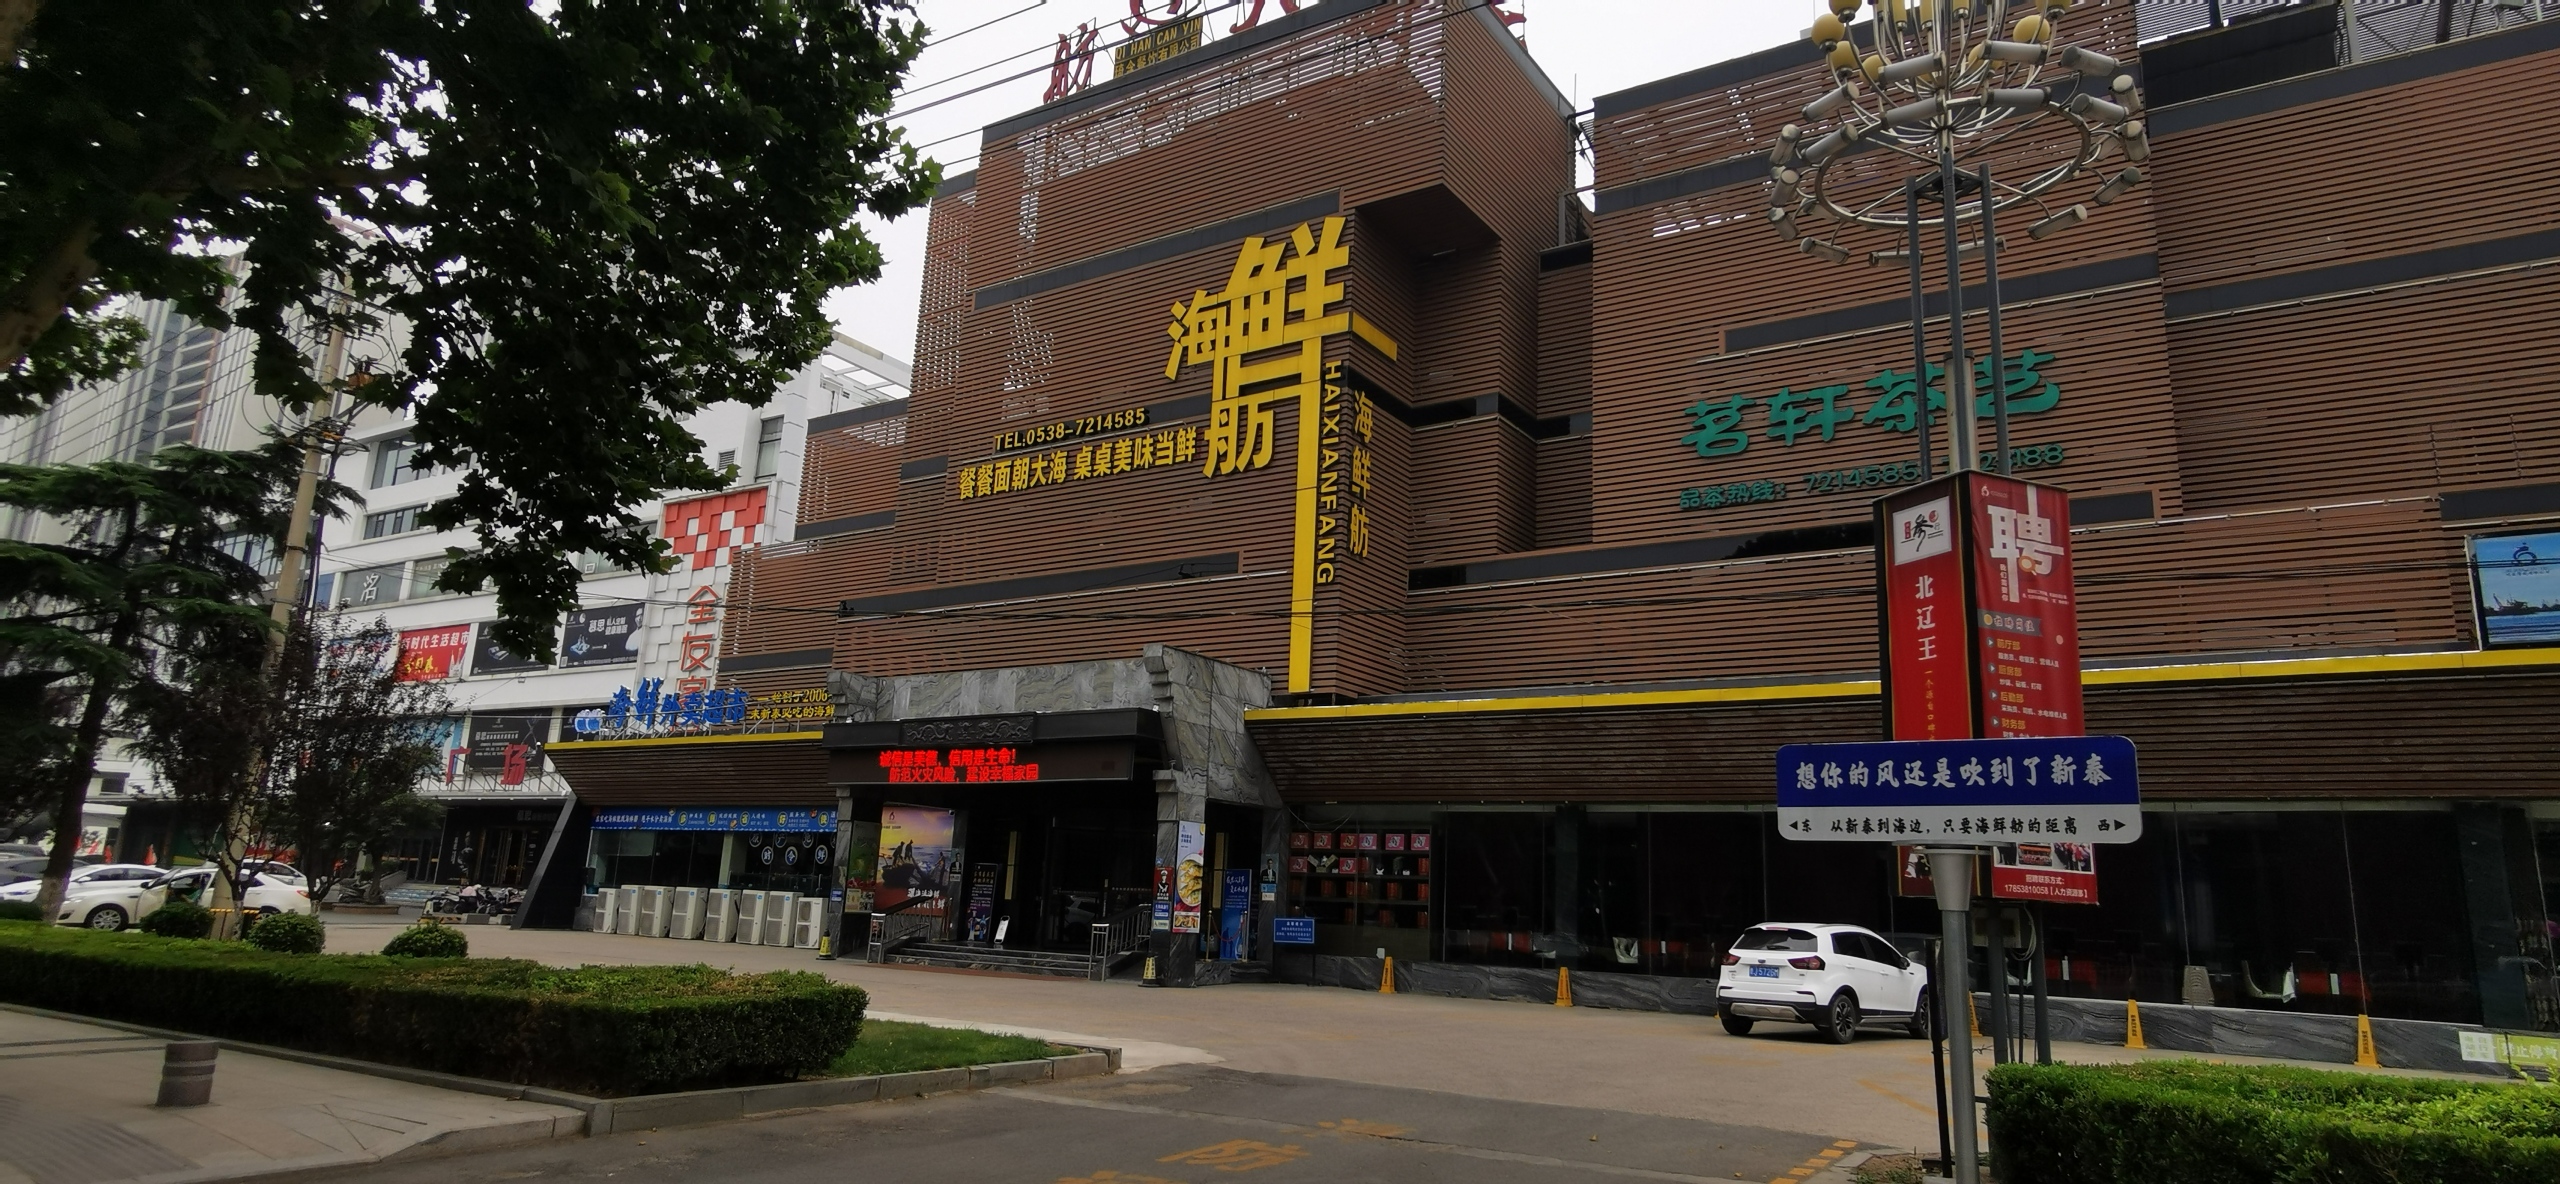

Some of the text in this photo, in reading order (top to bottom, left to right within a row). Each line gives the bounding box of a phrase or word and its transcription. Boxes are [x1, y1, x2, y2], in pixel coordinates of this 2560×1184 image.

[1116, 47, 1126, 60] QI
[1130, 36, 1151, 55] HAN
[1156, 27, 1178, 45] CAN
[1182, 16, 1201, 36] YIN
[1680, 349, 2062, 458] 茗轩茶艺
[959, 425, 1198, 499] 餐餐面朝大海 桌桌美味当鲜
[1317, 360, 1343, 585] HAIXIANFANG
[1349, 389, 1375, 560] 海鲜舫
[1803, 461, 1919, 495] 7214585
[1987, 484, 2065, 604] 聘
[1914, 574, 1938, 661] 北辽王
[607, 675, 749, 730] 海鲜外卖超市
[750, 703, 836, 720] 来新泰必吃的海鲜
[1796, 753, 2112, 790] 想你的风还是吹到了新泰
[1801, 818, 1812, 833] 东
[2098, 819, 2110, 833] 西
